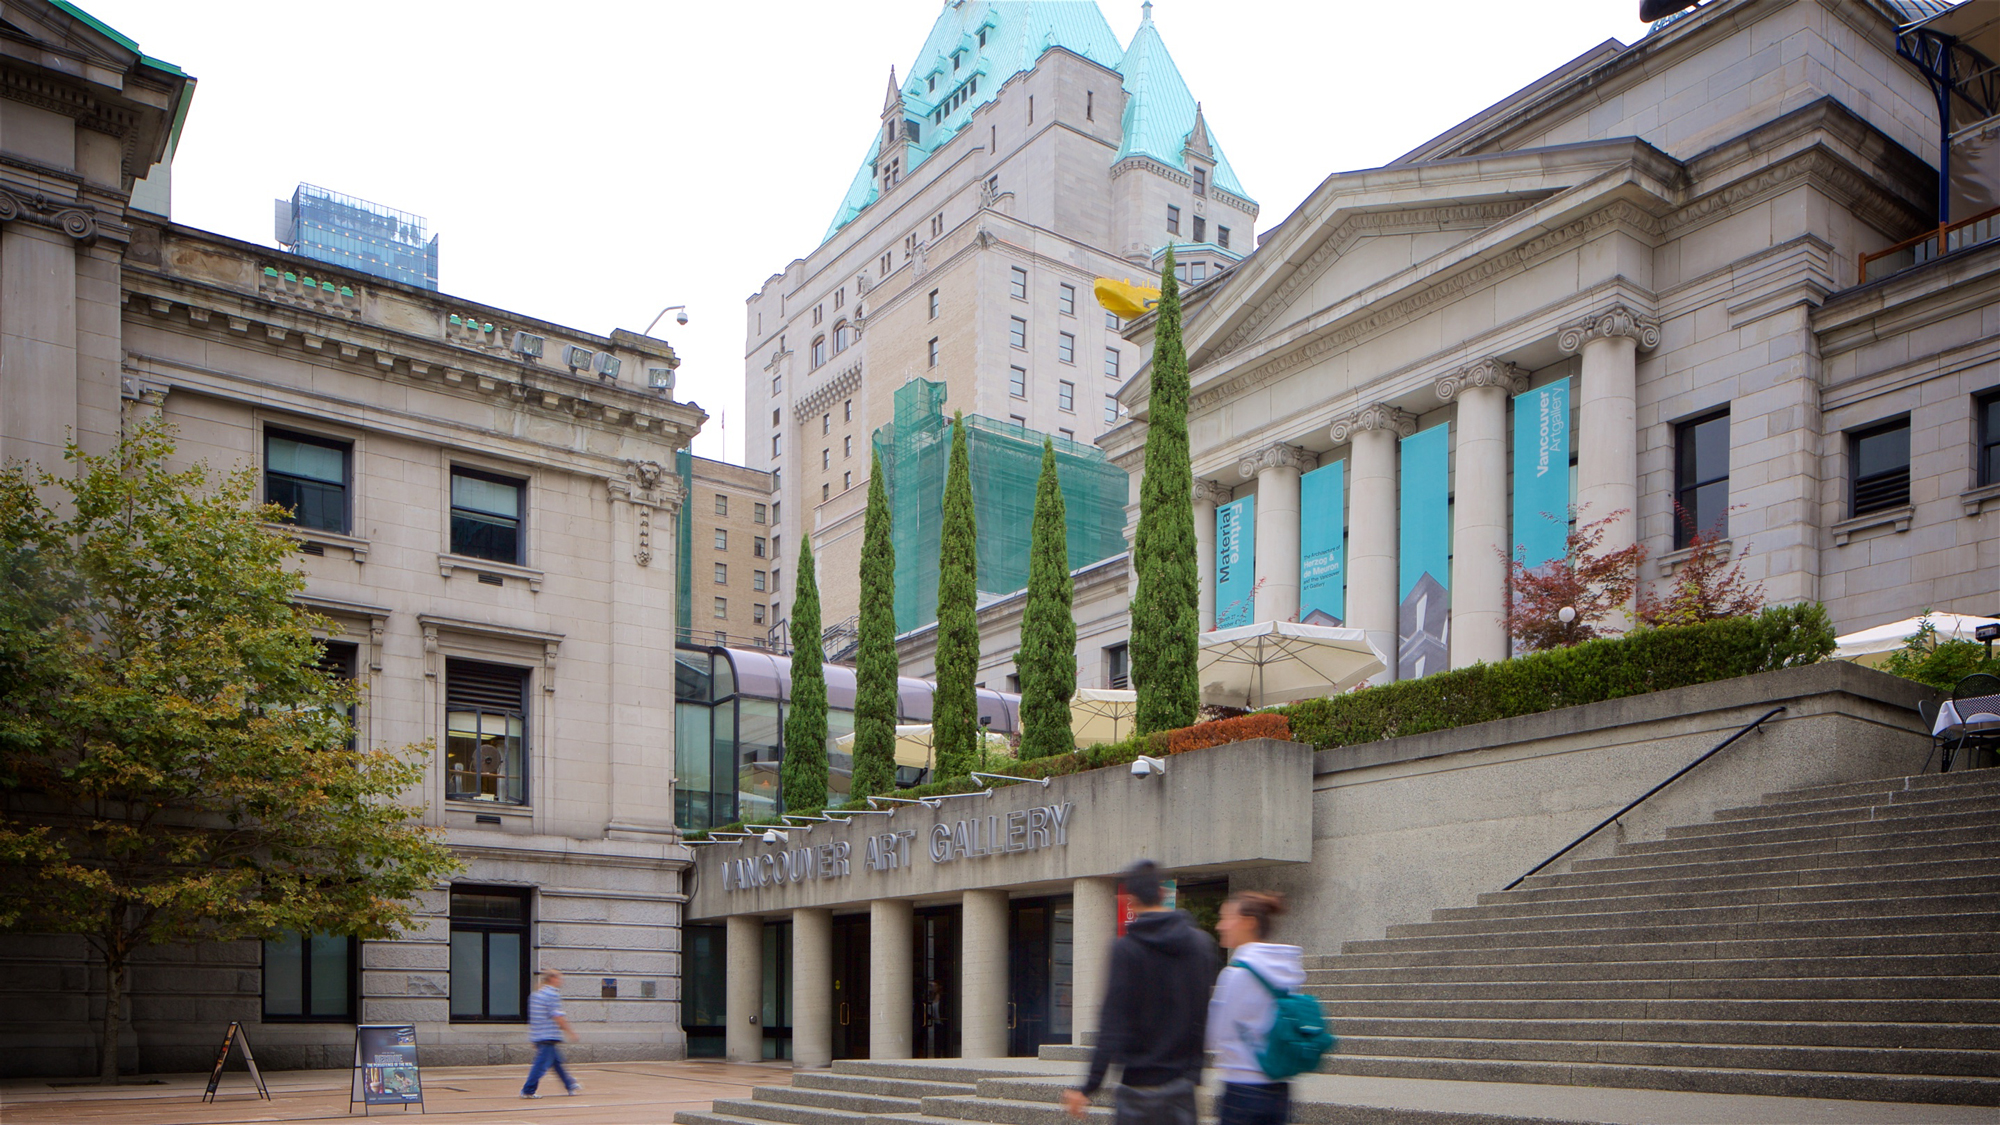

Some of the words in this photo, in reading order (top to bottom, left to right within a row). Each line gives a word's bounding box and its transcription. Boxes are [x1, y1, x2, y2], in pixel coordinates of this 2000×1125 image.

[1537, 391, 1549, 478] Vancouver
[1549, 387, 1564, 452] Artgallery
[1219, 507, 1231, 584] Material
[1230, 502, 1242, 564] Future
[1311, 547, 1336, 558] Architecture
[1303, 557, 1328, 569] Herzog
[1329, 553, 1335, 562] &
[1303, 570, 1312, 579] de
[1312, 562, 1339, 576] Meuron
[1319, 570, 1340, 581] Vancouver
[1309, 581, 1326, 590] Gallery
[721, 840, 852, 892] VANCOUVER
[864, 829, 917, 871] ART
[929, 802, 1075, 864] GALLERY
